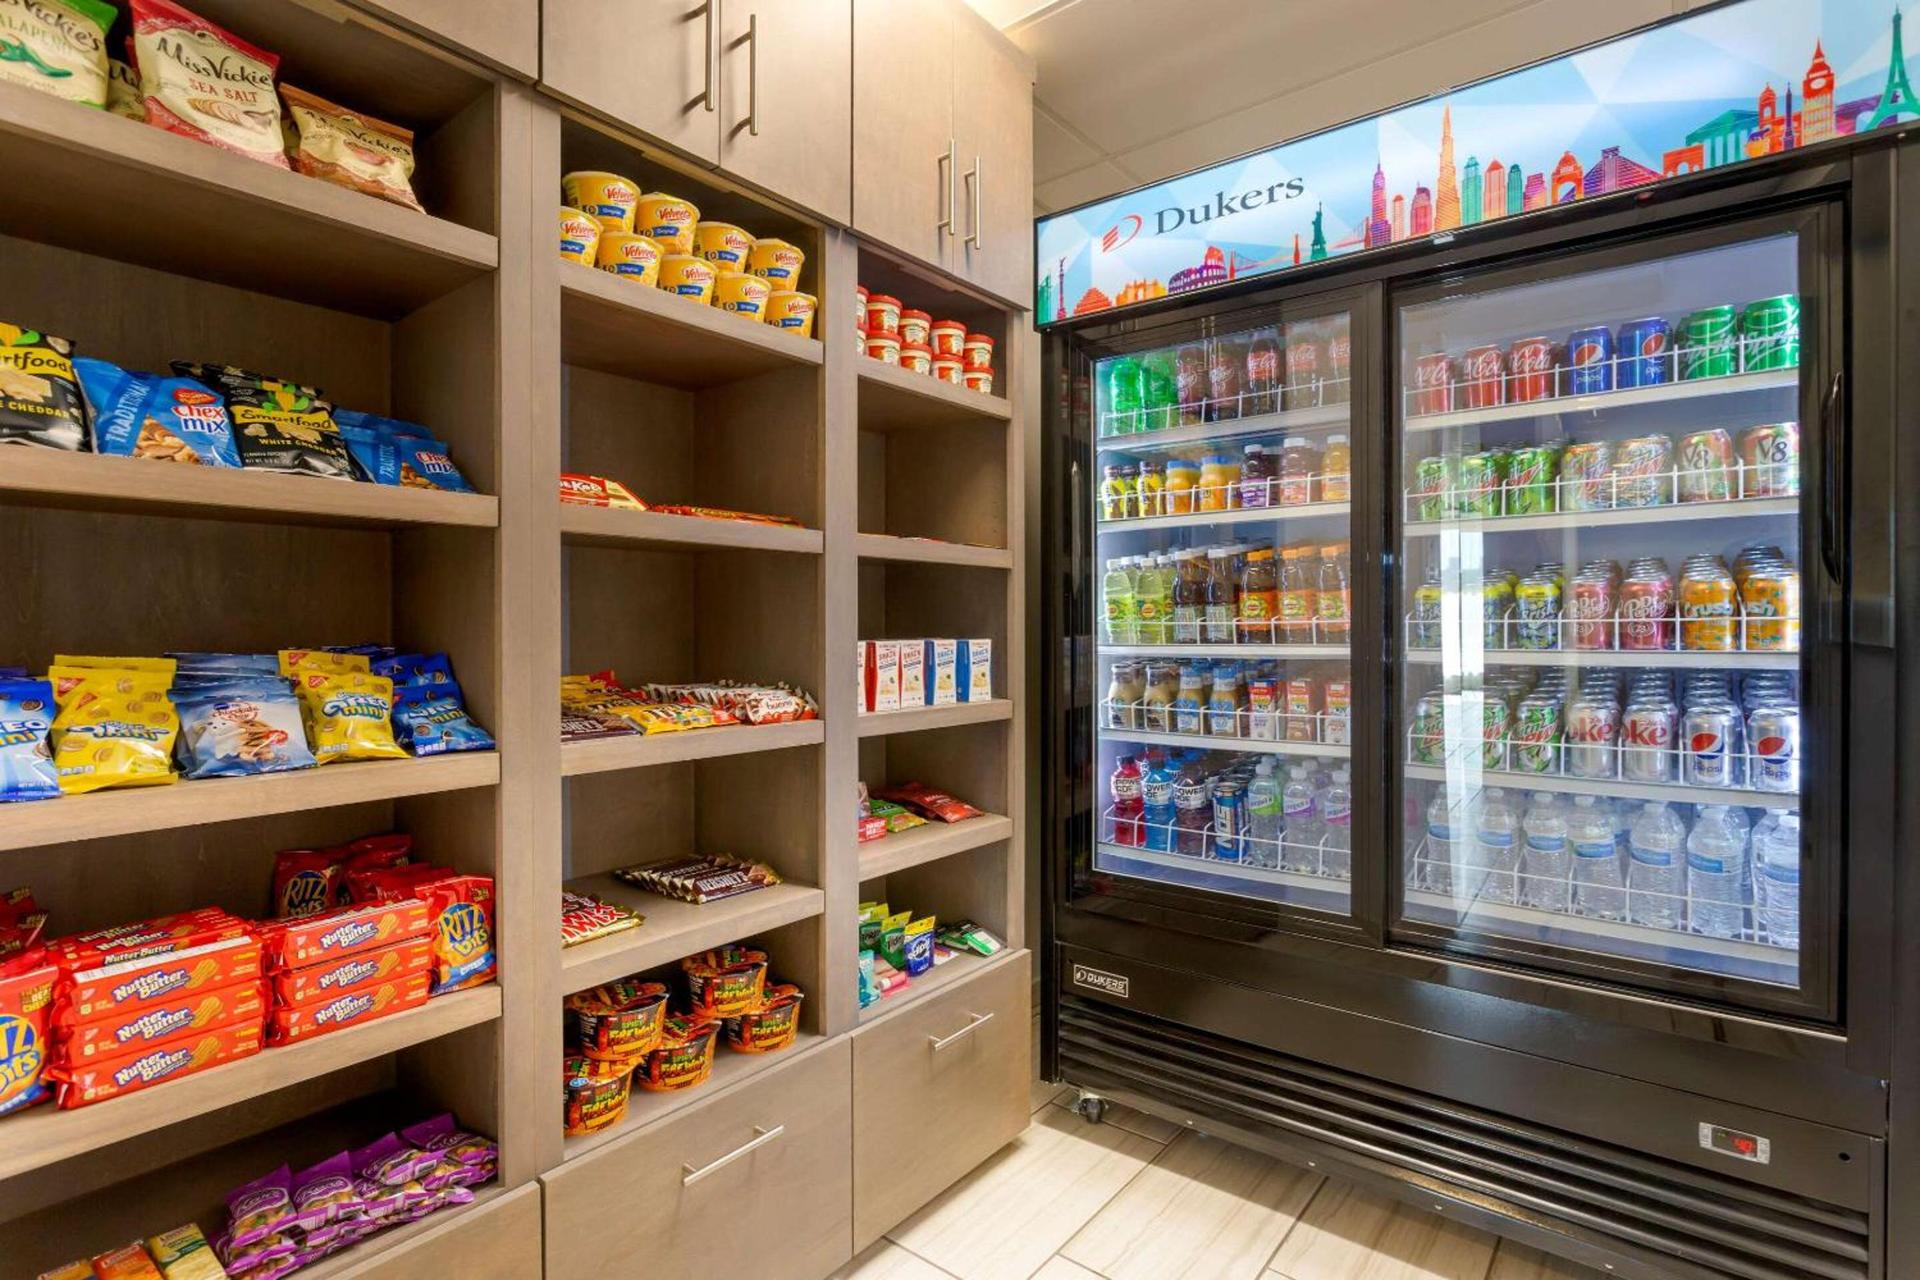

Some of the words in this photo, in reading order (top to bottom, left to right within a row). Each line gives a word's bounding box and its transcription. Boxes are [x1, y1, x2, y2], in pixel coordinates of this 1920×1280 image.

[189, 78, 219, 95] SEA
[223, 87, 257, 103] SALT
[1155, 177, 1304, 235] Dukers
[8, 401, 70, 418] CHEDDAR
[241, 408, 332, 430] Smartfood
[183, 418, 226, 434] mix
[1683, 447, 1709, 469] V8
[1757, 437, 1788, 463] V8
[696, 871, 748, 891] HERSHEY'S
[320, 922, 356, 948] Nutter
[340, 922, 376, 947] Butter
[440, 904, 485, 940] RITZ
[104, 950, 141, 965] Nutter
[139, 943, 174, 957] Butter
[113, 971, 162, 1001] Nutter
[140, 970, 186, 999] Butter
[319, 961, 356, 987] Nutter
[339, 961, 374, 985] Butter
[1087, 973, 1125, 989] DUKERS
[315, 996, 353, 1023] Nutter
[335, 995, 371, 1021] Butter
[117, 1010, 166, 1041] Nutter
[143, 1009, 190, 1039] Butter
[114, 1052, 164, 1085] Nutter
[142, 1050, 188, 1081] Butter
